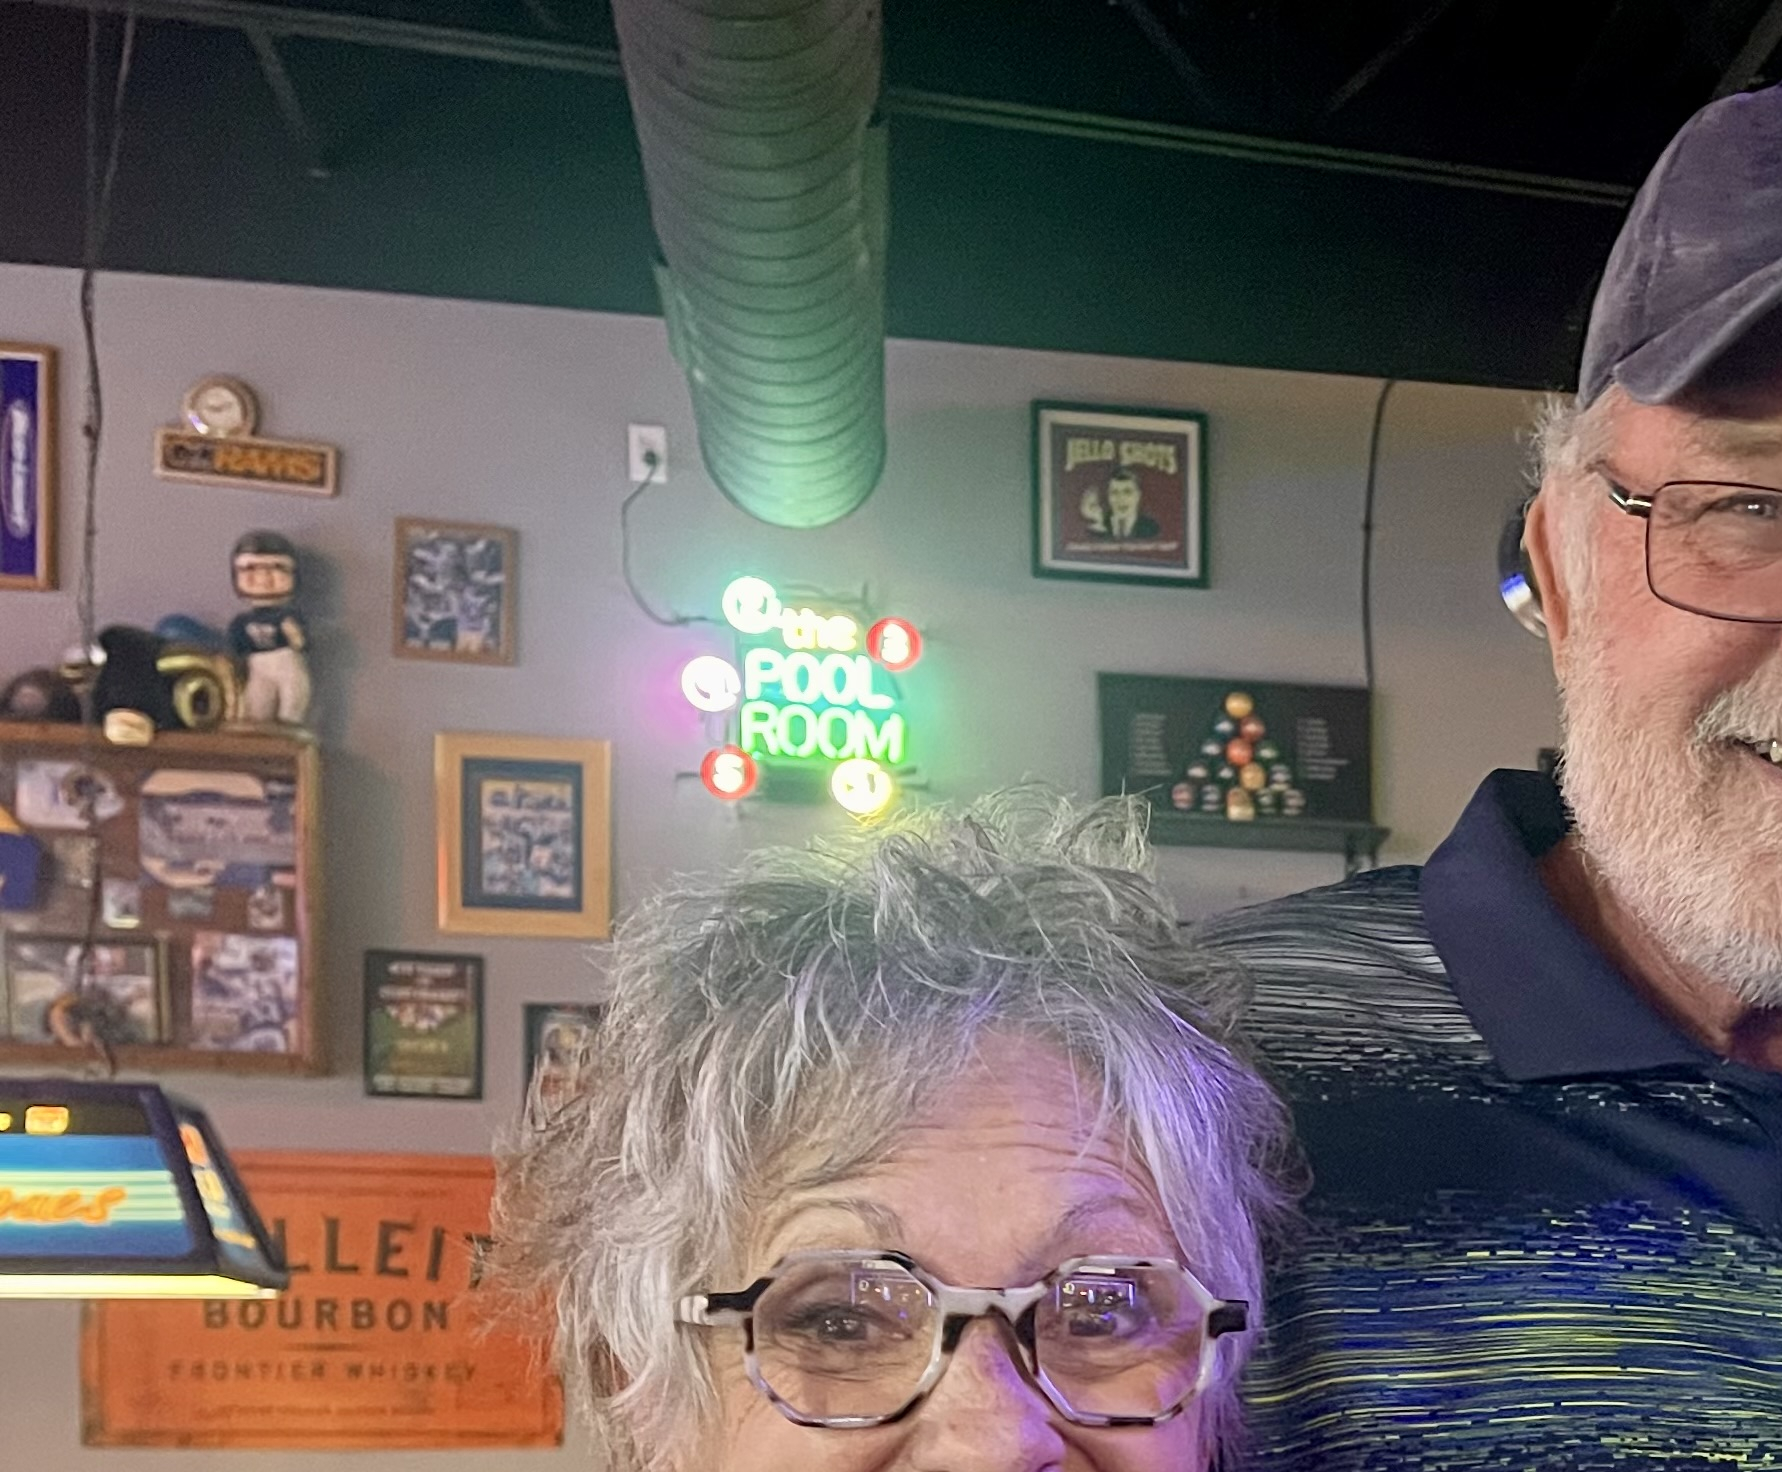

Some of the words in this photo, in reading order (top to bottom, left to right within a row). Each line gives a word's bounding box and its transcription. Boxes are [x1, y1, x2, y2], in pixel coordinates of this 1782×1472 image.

[1065, 438, 1115, 471] JELLO
[1119, 440, 1177, 474] SHOTS
[780, 607, 858, 651] the
[744, 647, 895, 709] POOL
[740, 700, 905, 765] ROOM
[204, 1299, 448, 1331] BOURBON
[168, 1359, 326, 1382] FRONTIER
[346, 1361, 476, 1384] WHISKEY
